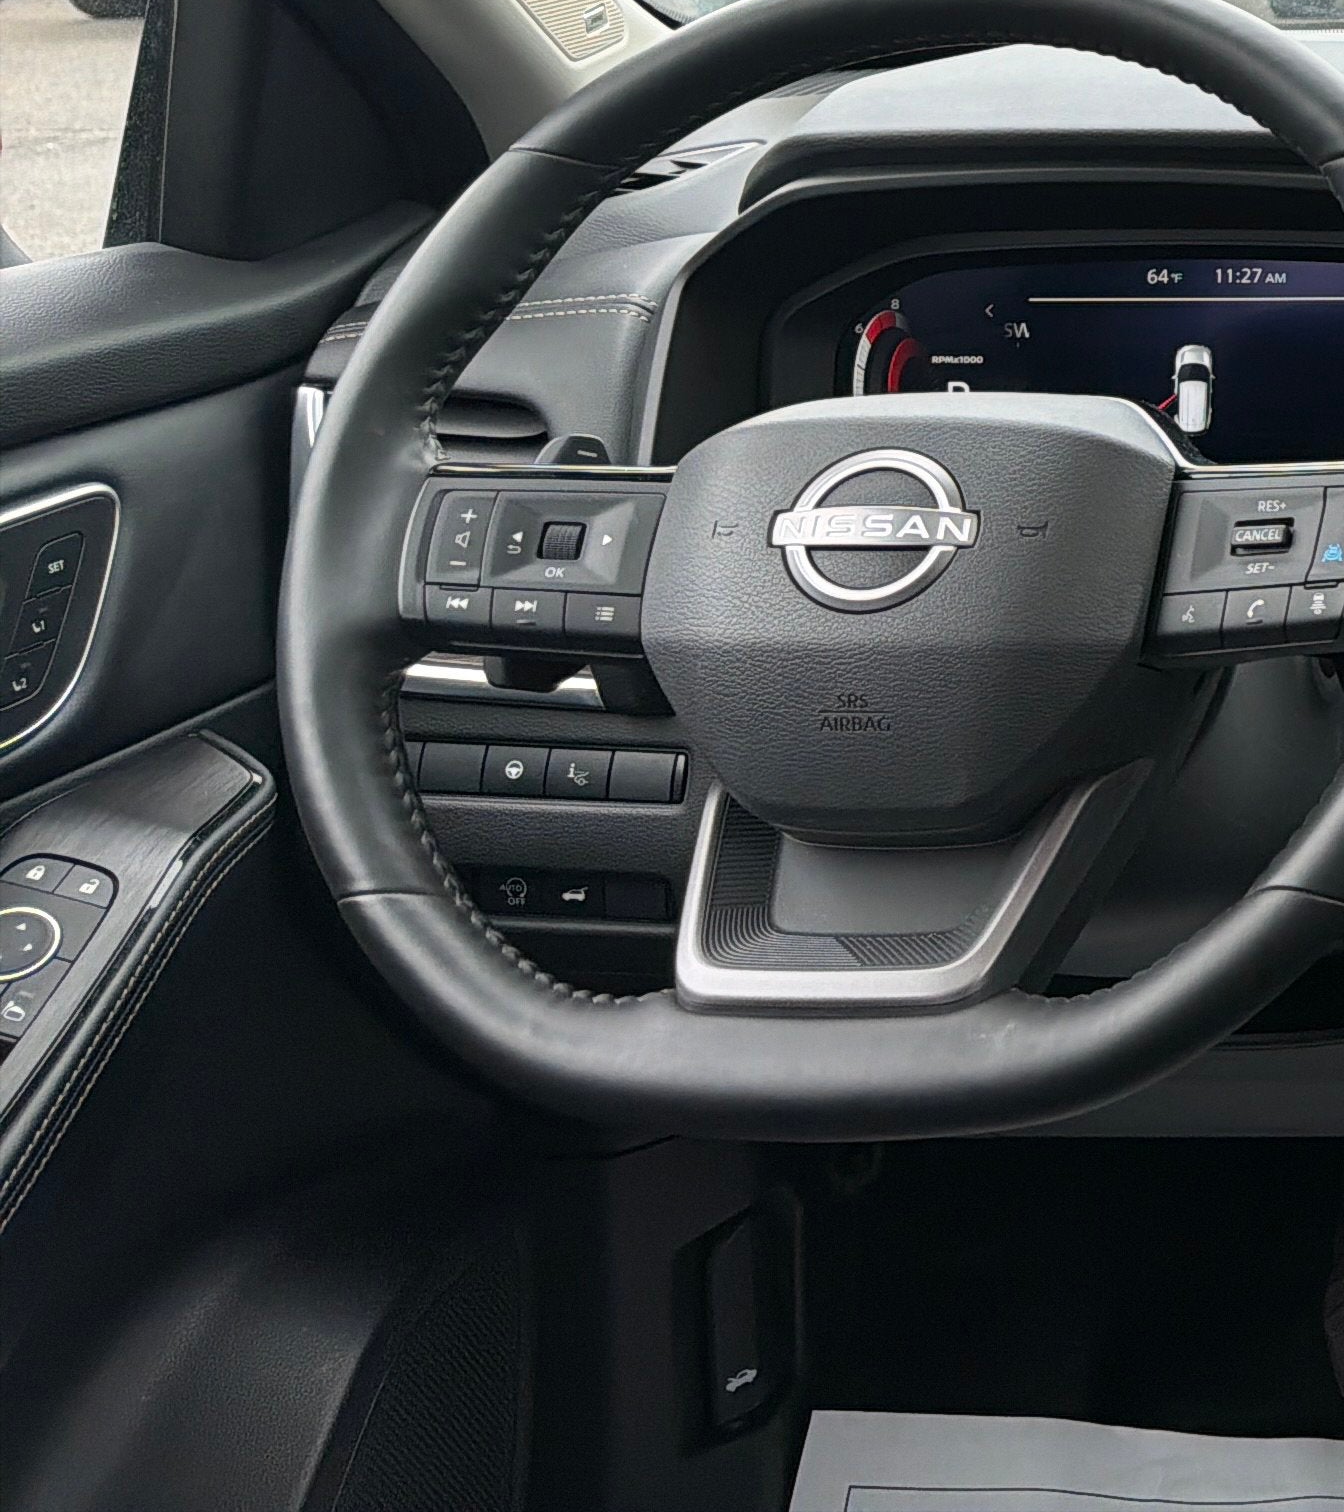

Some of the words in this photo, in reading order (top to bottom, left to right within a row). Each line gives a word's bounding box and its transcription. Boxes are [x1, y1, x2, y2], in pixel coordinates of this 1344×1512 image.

[1215, 268, 1263, 284] 11:27
[1265, 273, 1287, 284] AM
[891, 298, 900, 310] 8
[854, 322, 864, 334] 6
[931, 355, 984, 364] RPMx1000
[1257, 500, 1287, 512] RES+
[780, 513, 972, 542] NISSAN
[1235, 529, 1282, 542] CANCEL
[48, 560, 65, 574] SET
[544, 567, 566, 578] OK
[1245, 563, 1275, 574] SET-
[836, 693, 869, 708] SRS
[820, 716, 892, 731] AIRBAG
[500, 884, 523, 893] AUTO
[507, 897, 526, 906] OFF
